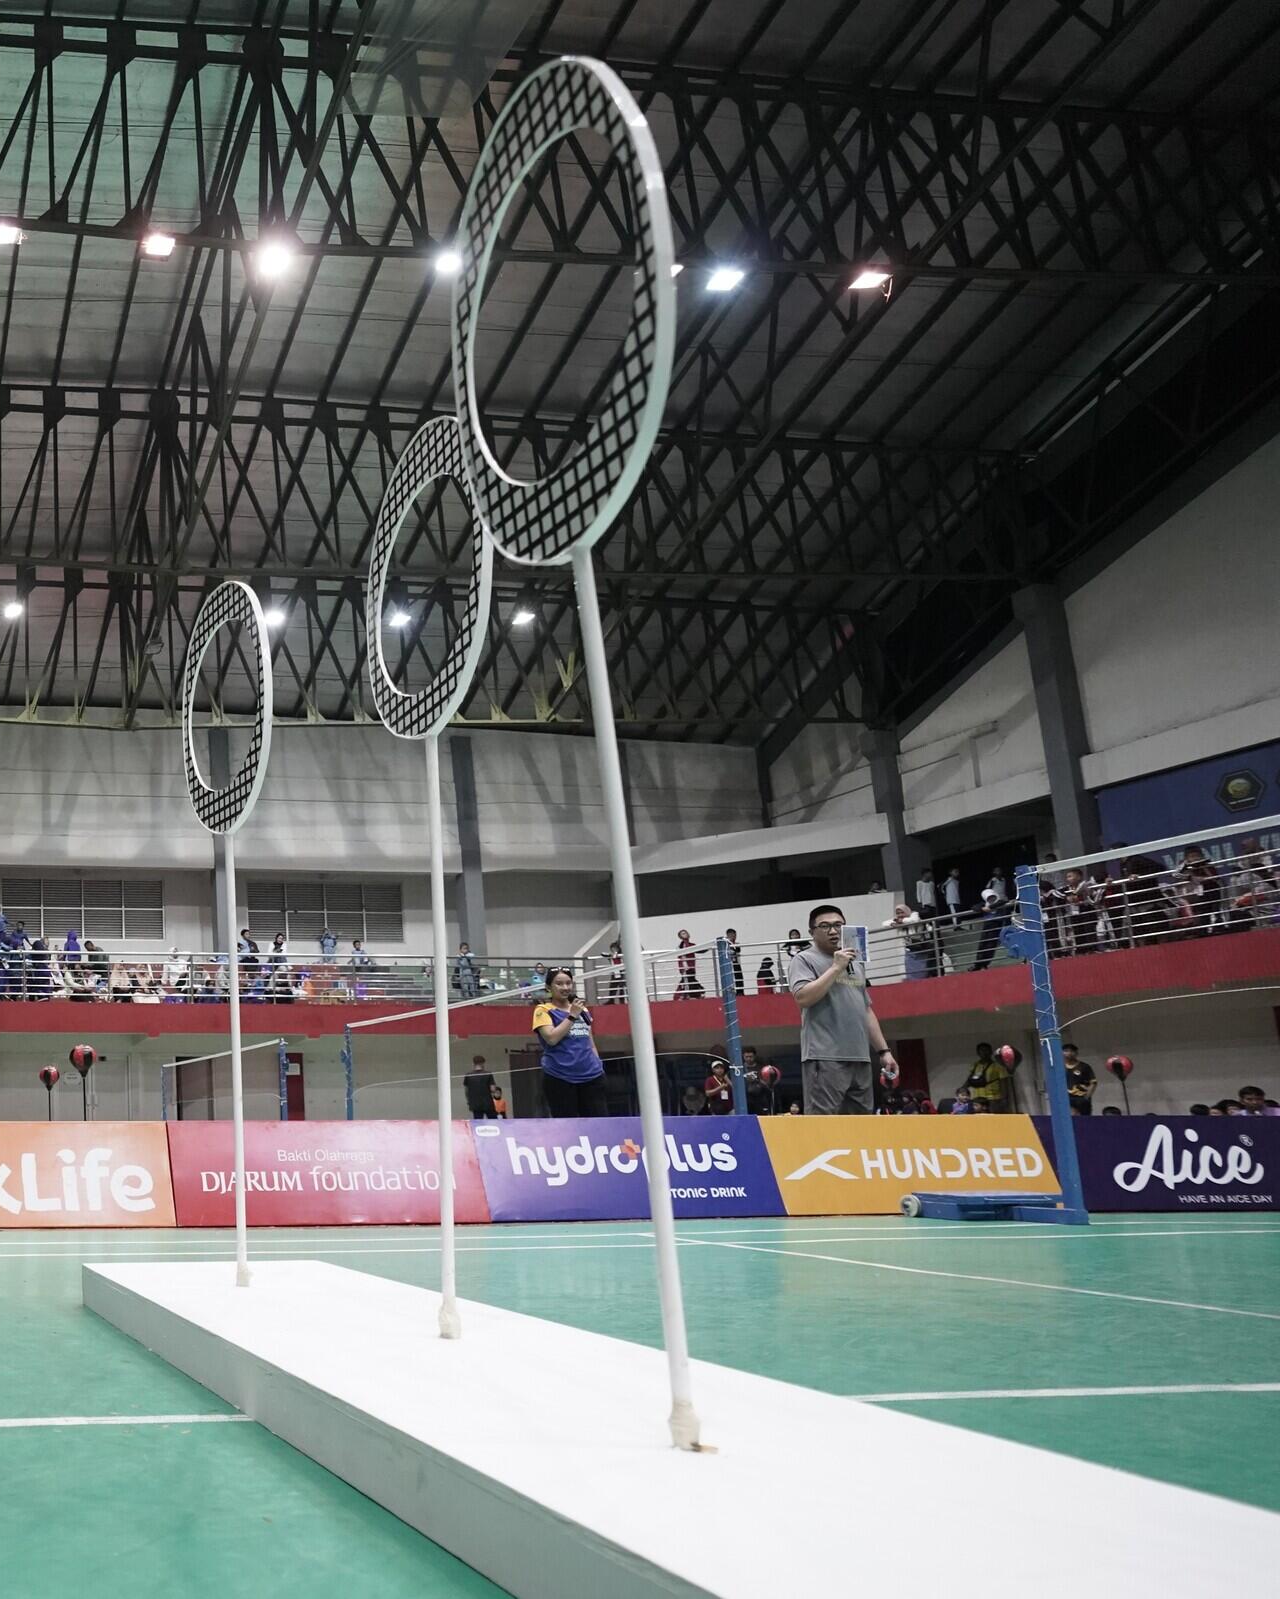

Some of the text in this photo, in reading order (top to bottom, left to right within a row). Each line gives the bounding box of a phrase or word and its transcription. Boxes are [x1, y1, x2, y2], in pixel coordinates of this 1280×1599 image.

[277, 1149, 375, 1164] Bakti Olahraga
[860, 1147, 1043, 1179] HUNDRED
[1112, 1124, 1265, 1192] Aice
[309, 1165, 456, 1192] foundatio
[670, 1186, 747, 1199] TONIC DRINK
[1178, 1194, 1273, 1204] HAVE AN AICE DAY
